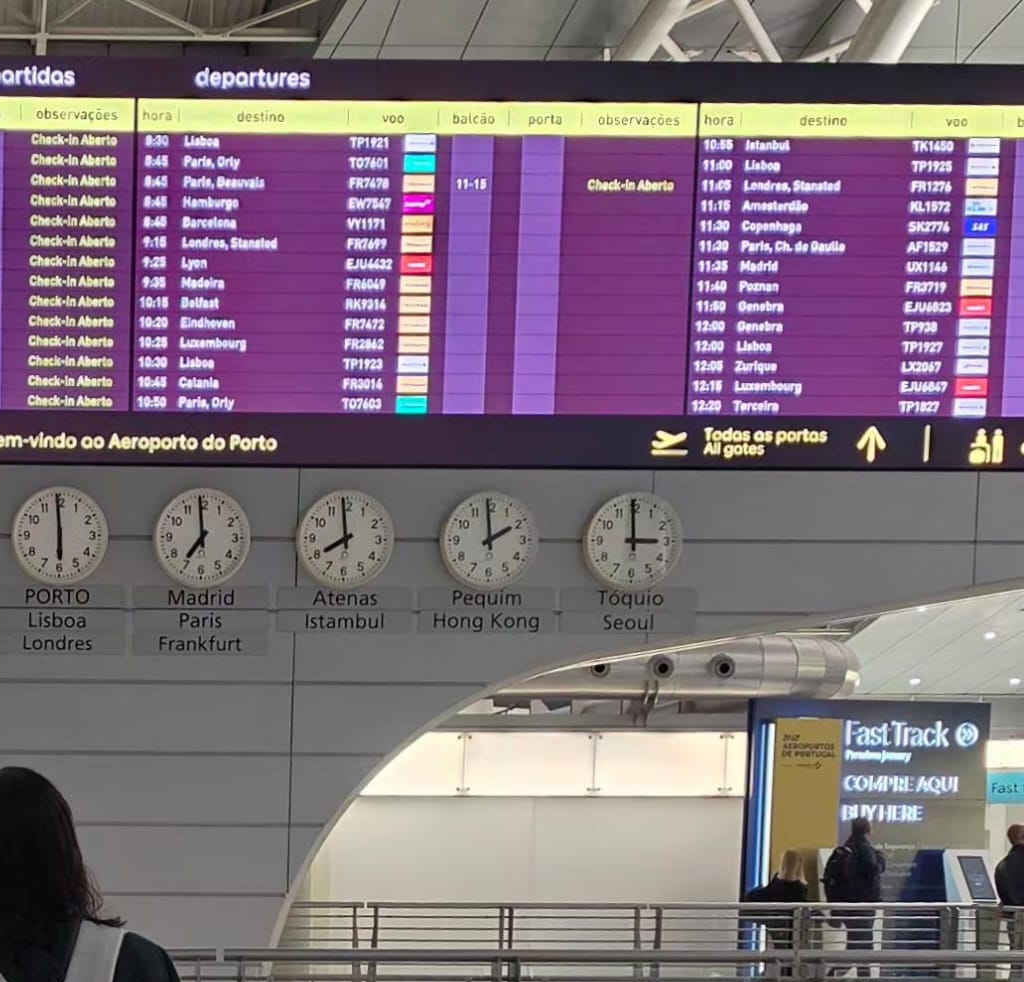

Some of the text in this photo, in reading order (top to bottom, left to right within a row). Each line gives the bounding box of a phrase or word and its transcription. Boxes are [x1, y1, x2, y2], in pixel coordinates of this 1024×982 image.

[196, 68, 309, 88] departures
[36, 108, 117, 121] observações
[143, 110, 679, 128] hora destino voo balcão porta observações
[705, 115, 967, 127] hora destino voo
[32, 134, 78, 144] Check-in
[82, 135, 117, 145] Aberto
[184, 136, 388, 148] Lisboa TP1921
[746, 140, 790, 151] Istanbul
[703, 160, 952, 172] 11:00 Lisboa TP1925
[457, 179, 674, 190] 11-15 Check-in Aberto
[183, 196, 239, 211] Hamburgo
[742, 200, 950, 212] Amesterdão KL1572
[182, 216, 385, 229] Barcelona VY1171
[739, 280, 946, 293] Poznan FR3719
[738, 301, 784, 312] Genebra
[140, 317, 235, 329] 10:20 Eindhoven
[696, 321, 725, 331] 12:00
[180, 337, 246, 352] Luxembourg
[343, 358, 383, 370] TP1923
[694, 360, 777, 374] 12:05 Zurique
[82, 437, 103, 448] ao
[109, 434, 195, 453] Aeroporto
[203, 434, 224, 450] do
[230, 435, 277, 450] Porto
[705, 428, 827, 445] Todas as portas
[704, 443, 764, 457] All gates
[26, 589, 89, 604] PORTO
[166, 589, 234, 609] Madrid
[313, 591, 377, 605] Atenas
[453, 590, 521, 608] Pequim
[597, 590, 663, 609] Tóquio
[29, 612, 86, 628] Lisboa
[180, 613, 221, 628] Paris
[306, 613, 383, 629] Istambul
[434, 613, 539, 632] Hong Kong
[604, 615, 653, 630] Seoul
[24, 635, 92, 650] Londres
[160, 636, 240, 651] Frankfurt
[845, 720, 950, 748] Fast Track
[844, 775, 959, 795] COMPRE AQUI
[991, 782, 1018, 794] Fast
[841, 803, 924, 822] BUY HERE
